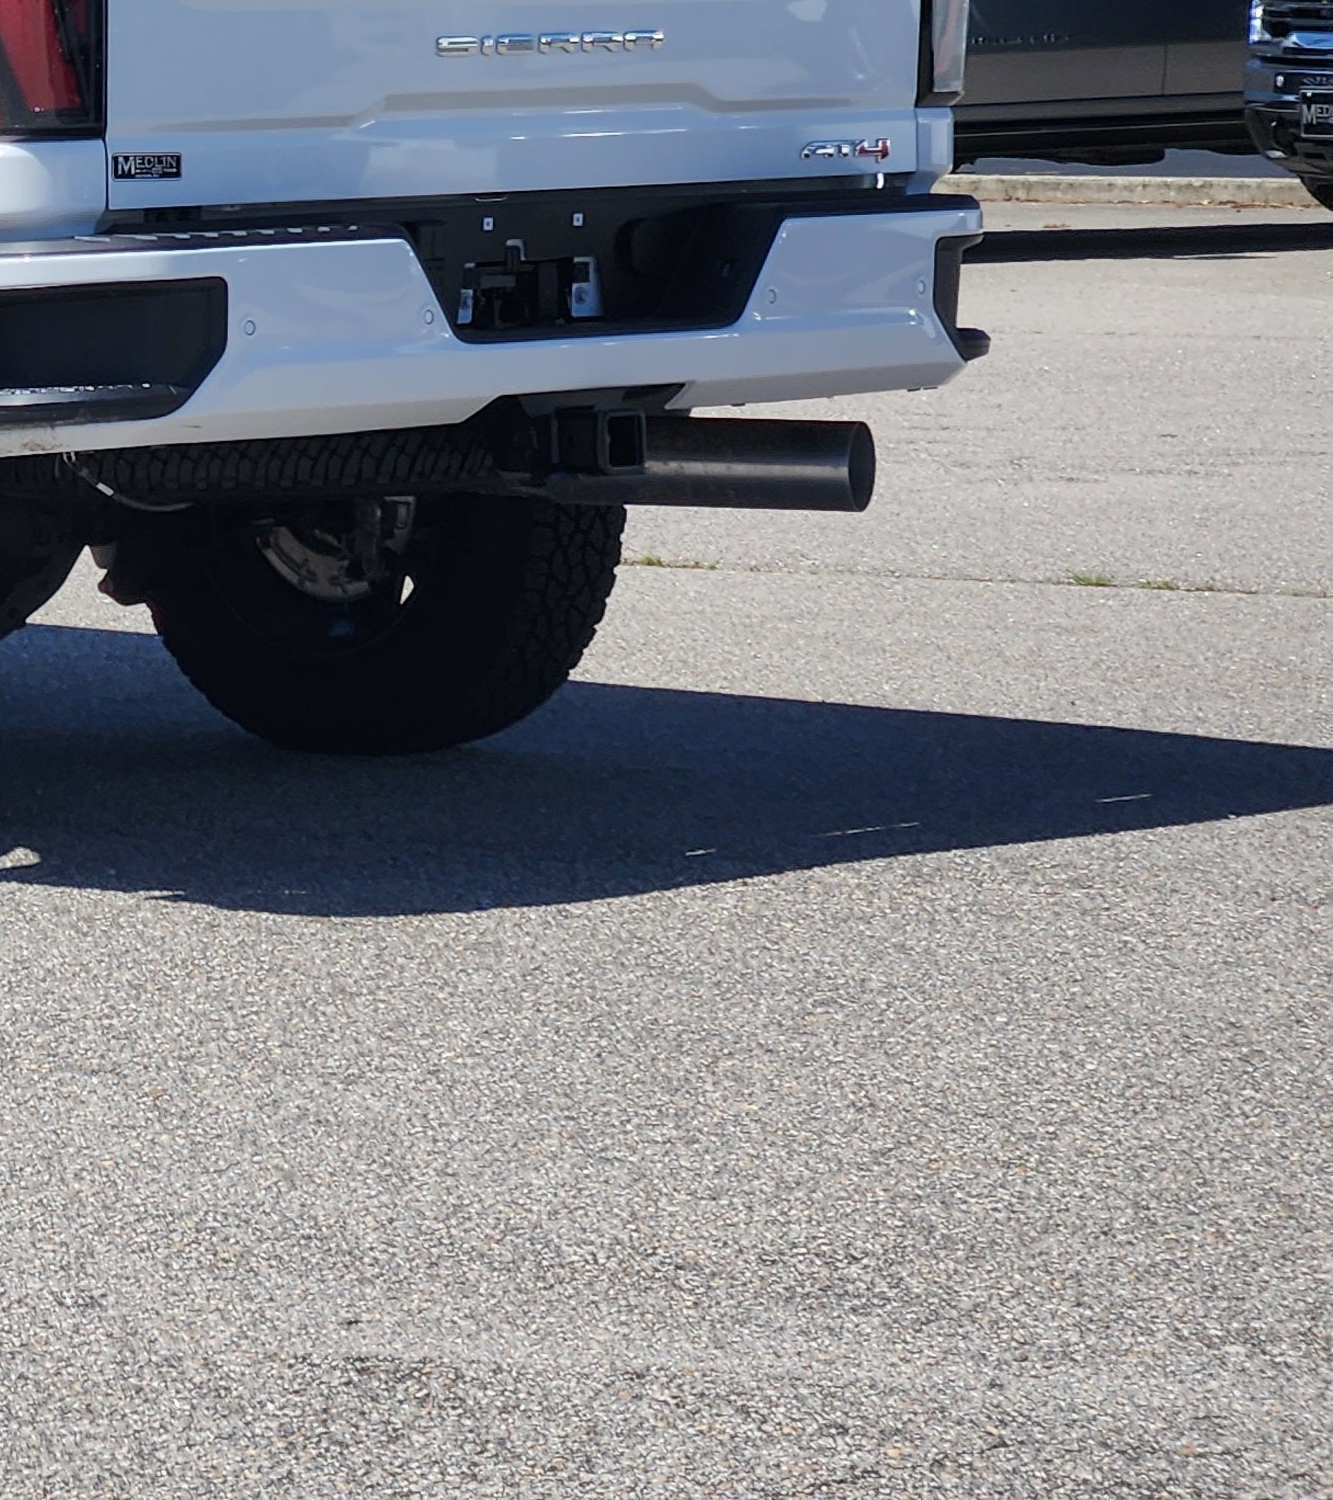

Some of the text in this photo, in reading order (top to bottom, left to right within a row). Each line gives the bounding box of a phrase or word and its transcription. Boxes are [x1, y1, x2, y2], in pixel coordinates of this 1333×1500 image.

[436, 29, 665, 57] SIERRA
[800, 137, 891, 164] AT4
[118, 156, 177, 175] MEDLIN
